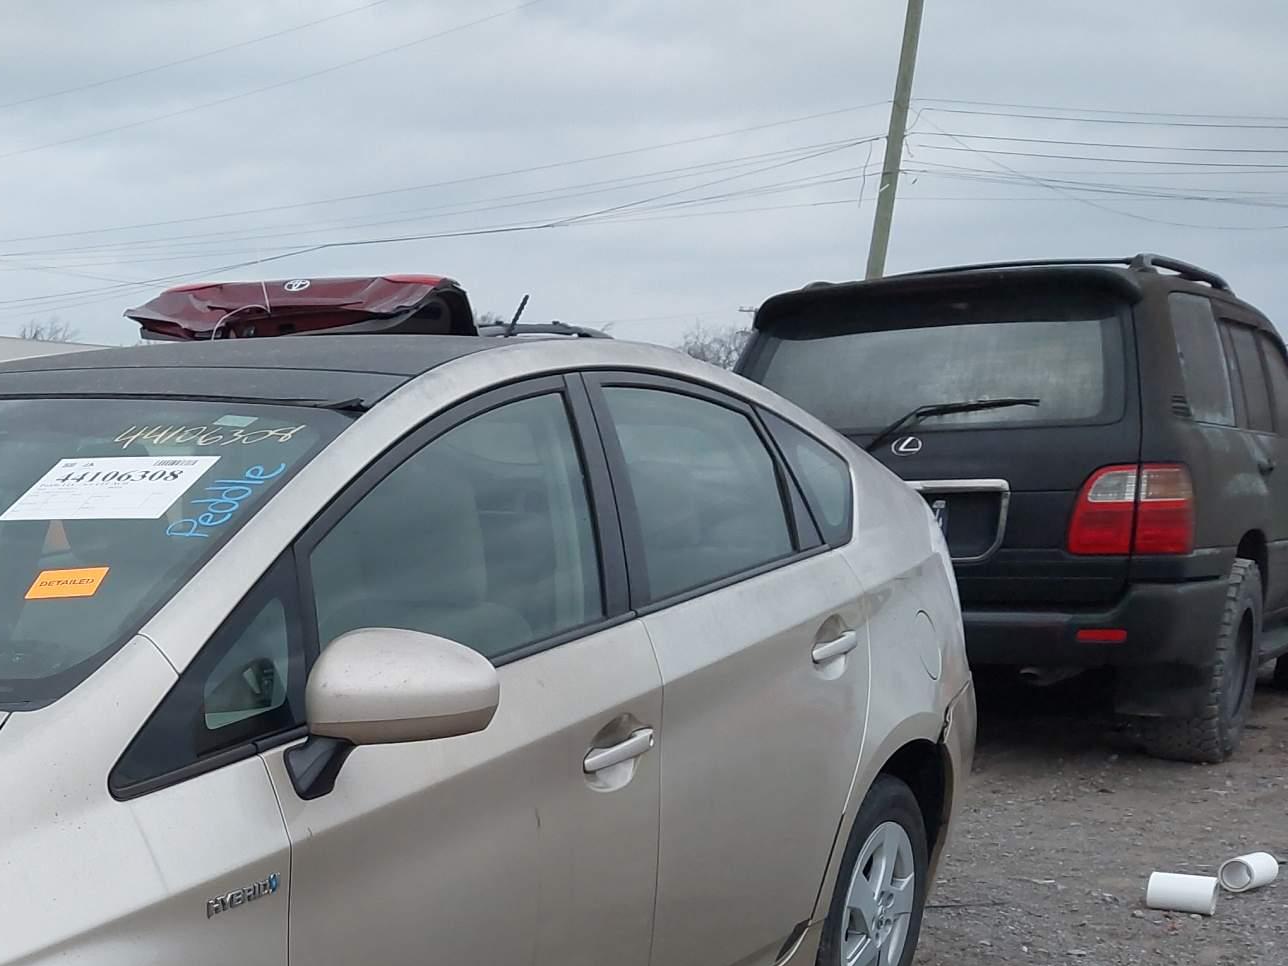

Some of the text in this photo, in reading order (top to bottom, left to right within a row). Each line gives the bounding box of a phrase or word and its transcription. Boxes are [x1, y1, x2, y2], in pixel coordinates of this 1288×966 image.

[114, 424, 307, 449] 44106308
[56, 470, 183, 483] 44106308
[166, 462, 287, 538] Peddle
[40, 578, 94, 587] DETAILED
[206, 878, 271, 919] HYBRID
